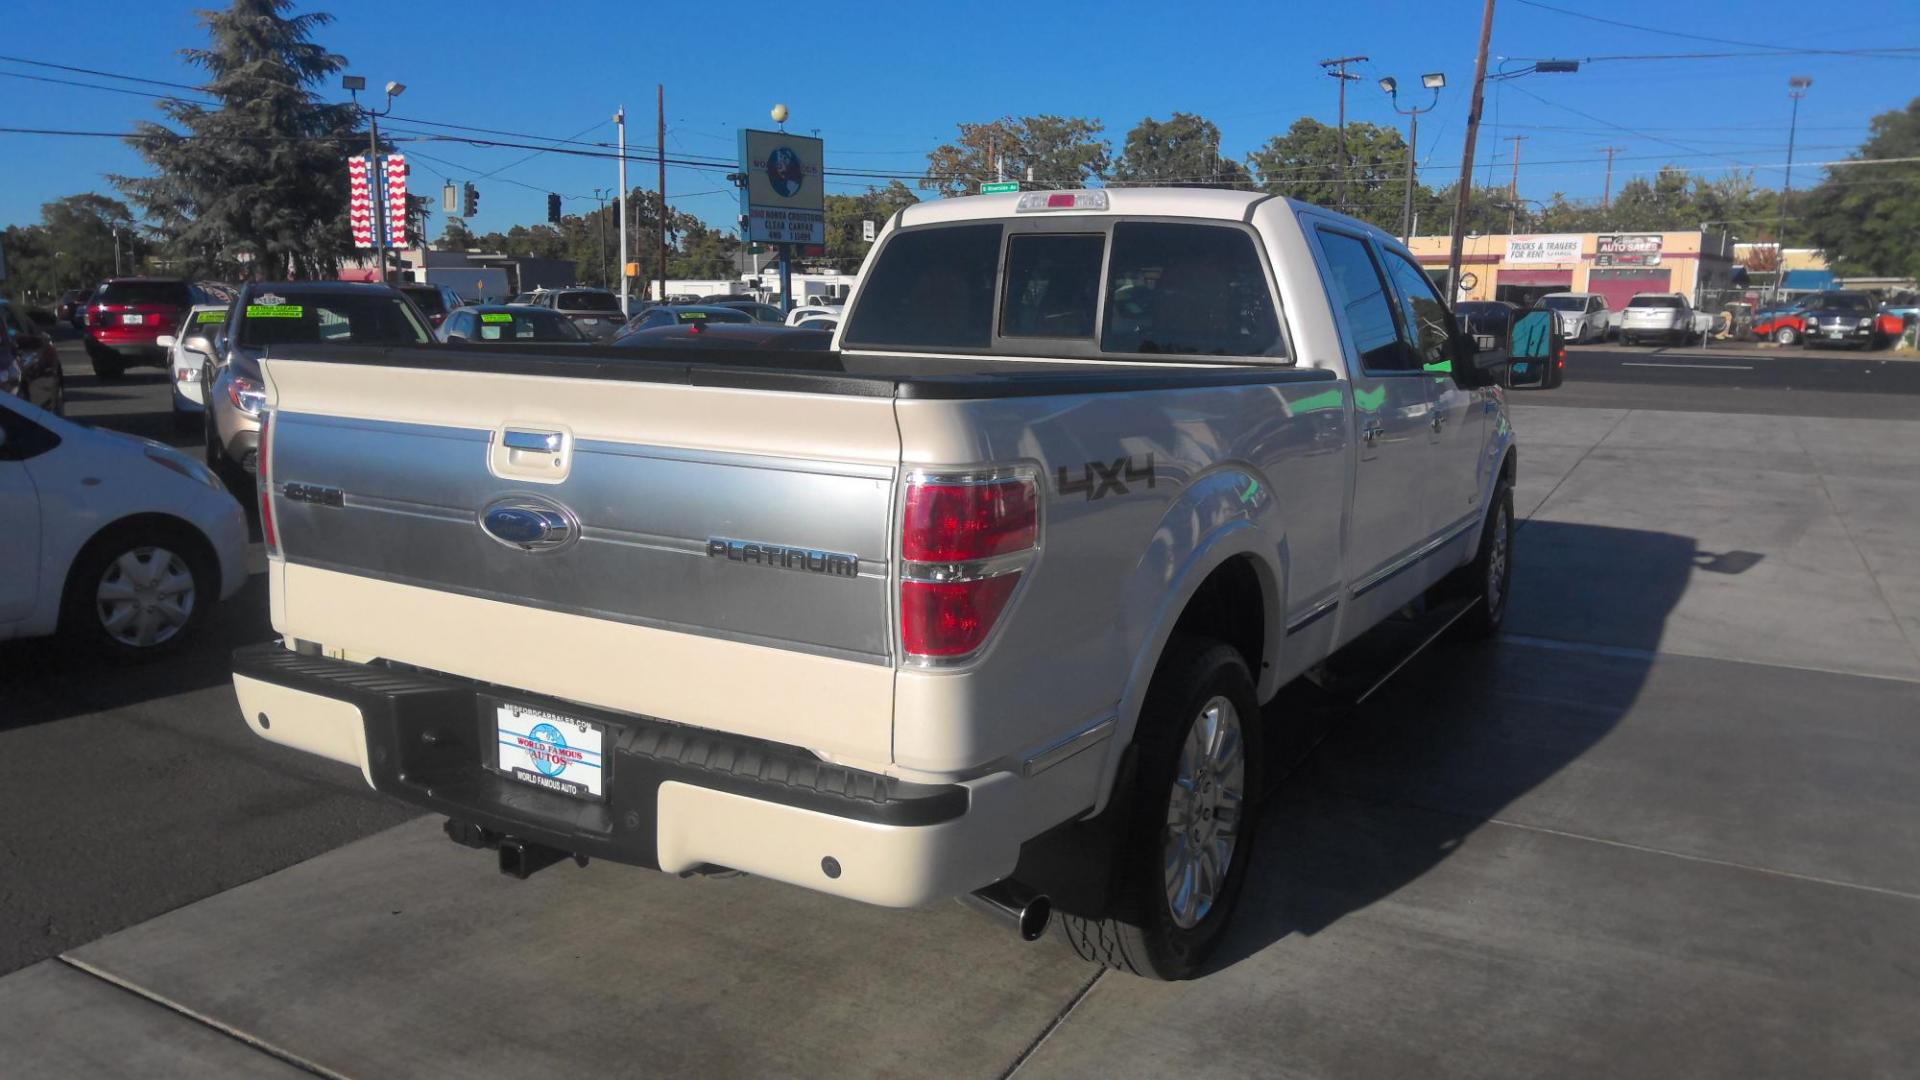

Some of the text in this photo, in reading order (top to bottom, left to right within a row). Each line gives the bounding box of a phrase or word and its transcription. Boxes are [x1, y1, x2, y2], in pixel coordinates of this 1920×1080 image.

[384, 183, 392, 242] FINANCE
[1511, 242, 1536, 250] TRUCKS
[1546, 241, 1577, 250] TRAILERS
[1511, 250, 1525, 258] FOR
[1527, 250, 1545, 258] RENT
[1600, 243, 1659, 252] AUTO SALES
[1058, 452, 1156, 502] 4X4
[707, 536, 859, 579] PLATINUM
[517, 737, 583, 760] WORLD FAMOUS
[531, 750, 567, 766] AUTOS
[516, 771, 577, 795] WORLD FAMOUS AUTO
